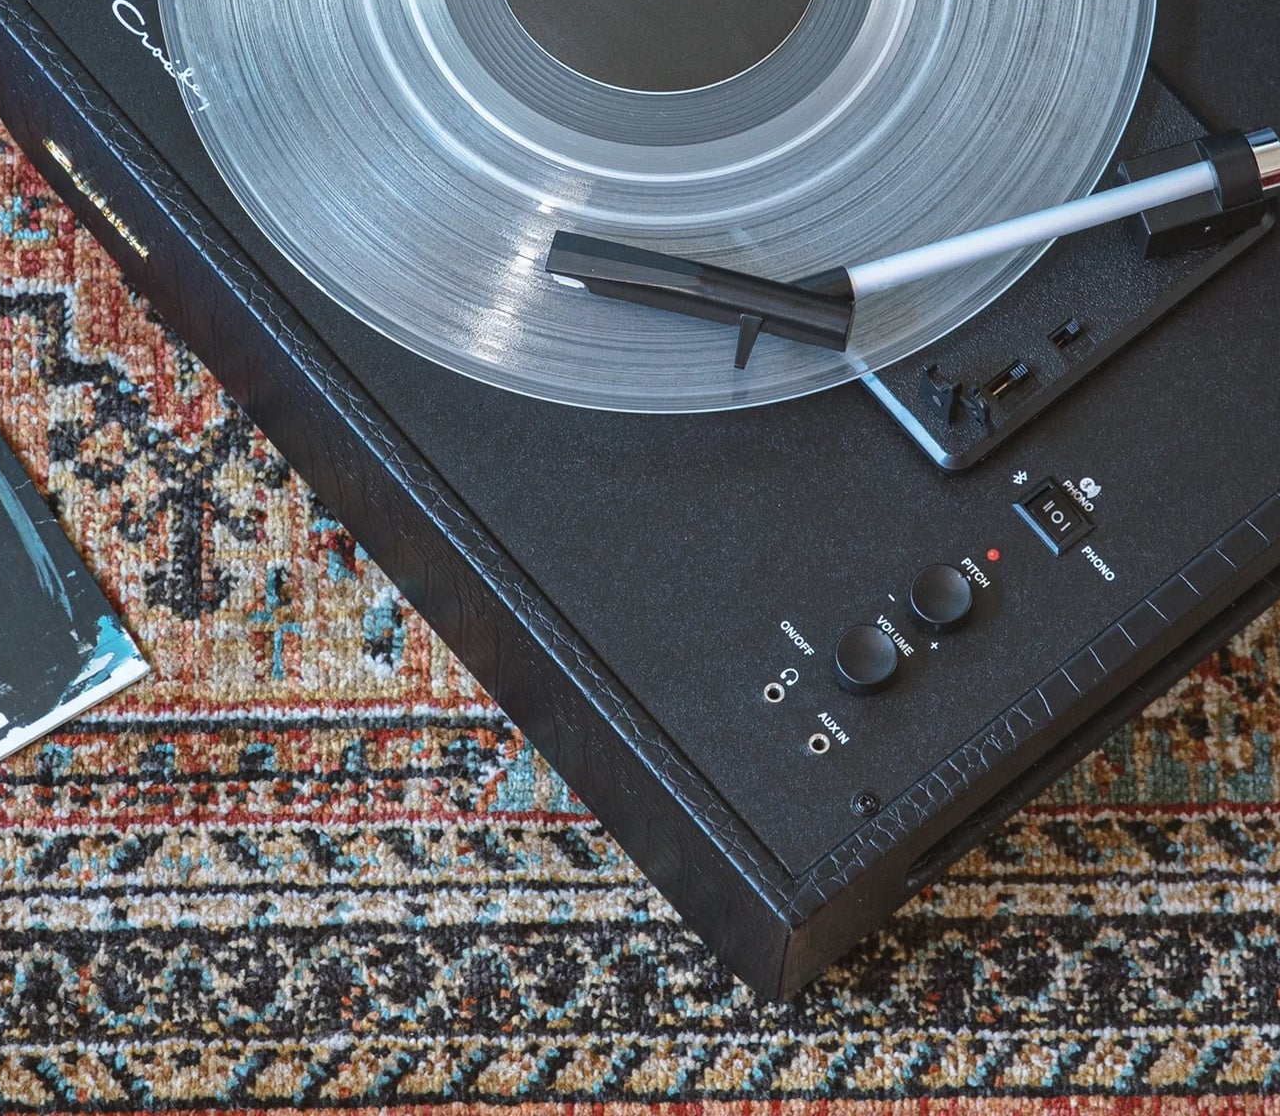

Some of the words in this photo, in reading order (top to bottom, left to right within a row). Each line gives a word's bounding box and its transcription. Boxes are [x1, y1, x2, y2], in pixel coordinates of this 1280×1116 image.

[1062, 479, 1095, 512] PHONO
[961, 557, 991, 588] PITCH
[1081, 545, 1115, 581] PHONO
[780, 620, 815, 656] ON/OFF
